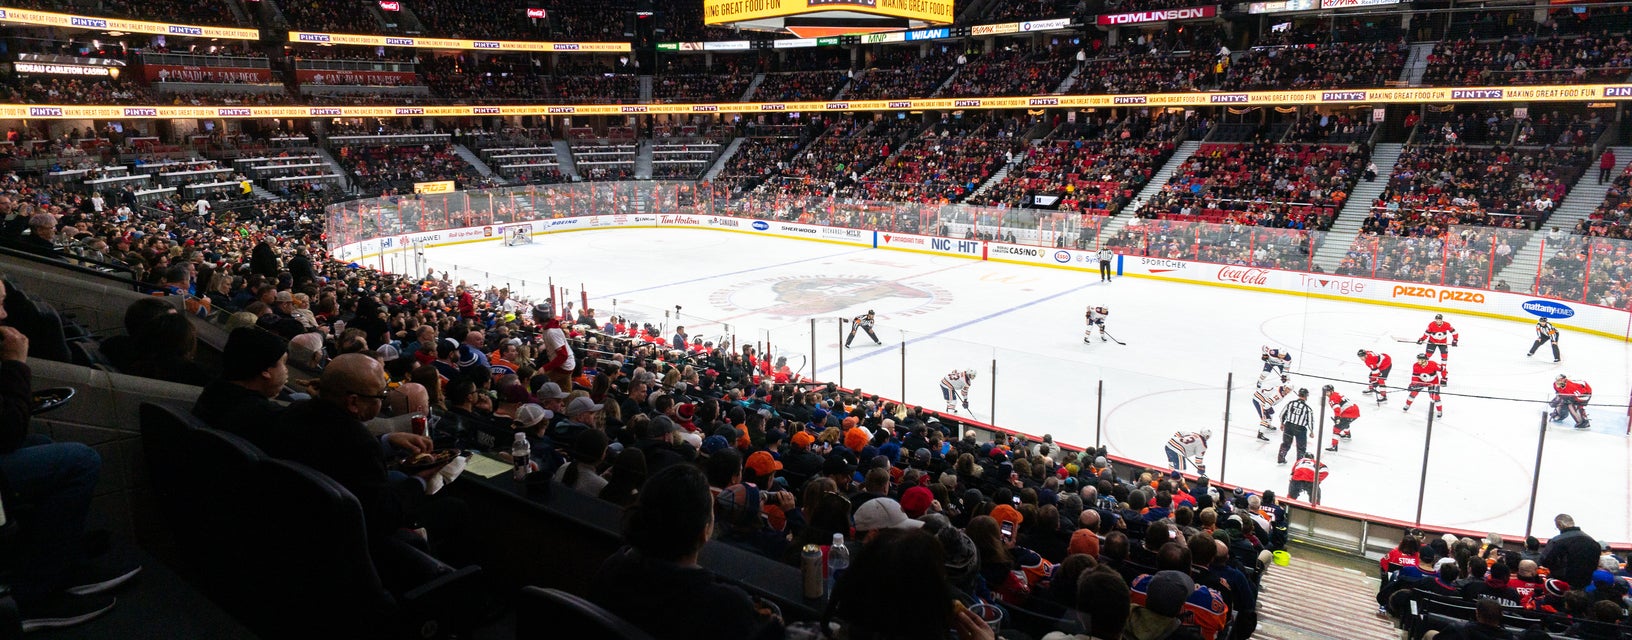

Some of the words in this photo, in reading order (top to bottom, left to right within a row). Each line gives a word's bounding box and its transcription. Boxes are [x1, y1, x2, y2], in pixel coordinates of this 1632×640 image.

[721, 2, 742, 16] GREAT
[745, 0, 763, 12] FOOD
[766, 0, 780, 9] FUN
[909, 0, 928, 12] GREAT
[930, 2, 944, 15] FOOD
[1108, 8, 1204, 24] TOMLINSON
[868, 34, 886, 42] MNP
[15, 64, 44, 72] RIDEAU
[46, 66, 82, 74] CARLETON
[1395, 92, 1413, 100] GREAT
[1454, 90, 1500, 98] PINTY'S
[1507, 90, 1534, 98] MAKING
[1561, 89, 1579, 97] FOOD
[1582, 89, 1595, 97] FUN
[660, 215, 673, 224] Tim
[674, 215, 699, 224] Hortons
[412, 234, 441, 243] HUAWEI
[932, 238, 950, 250] NIC
[958, 241, 978, 253] HIT
[1010, 248, 1037, 256] CASINO
[1393, 286, 1436, 298] pizza
[1439, 289, 1484, 303] pizza
[1399, 557, 1415, 566] STONE
